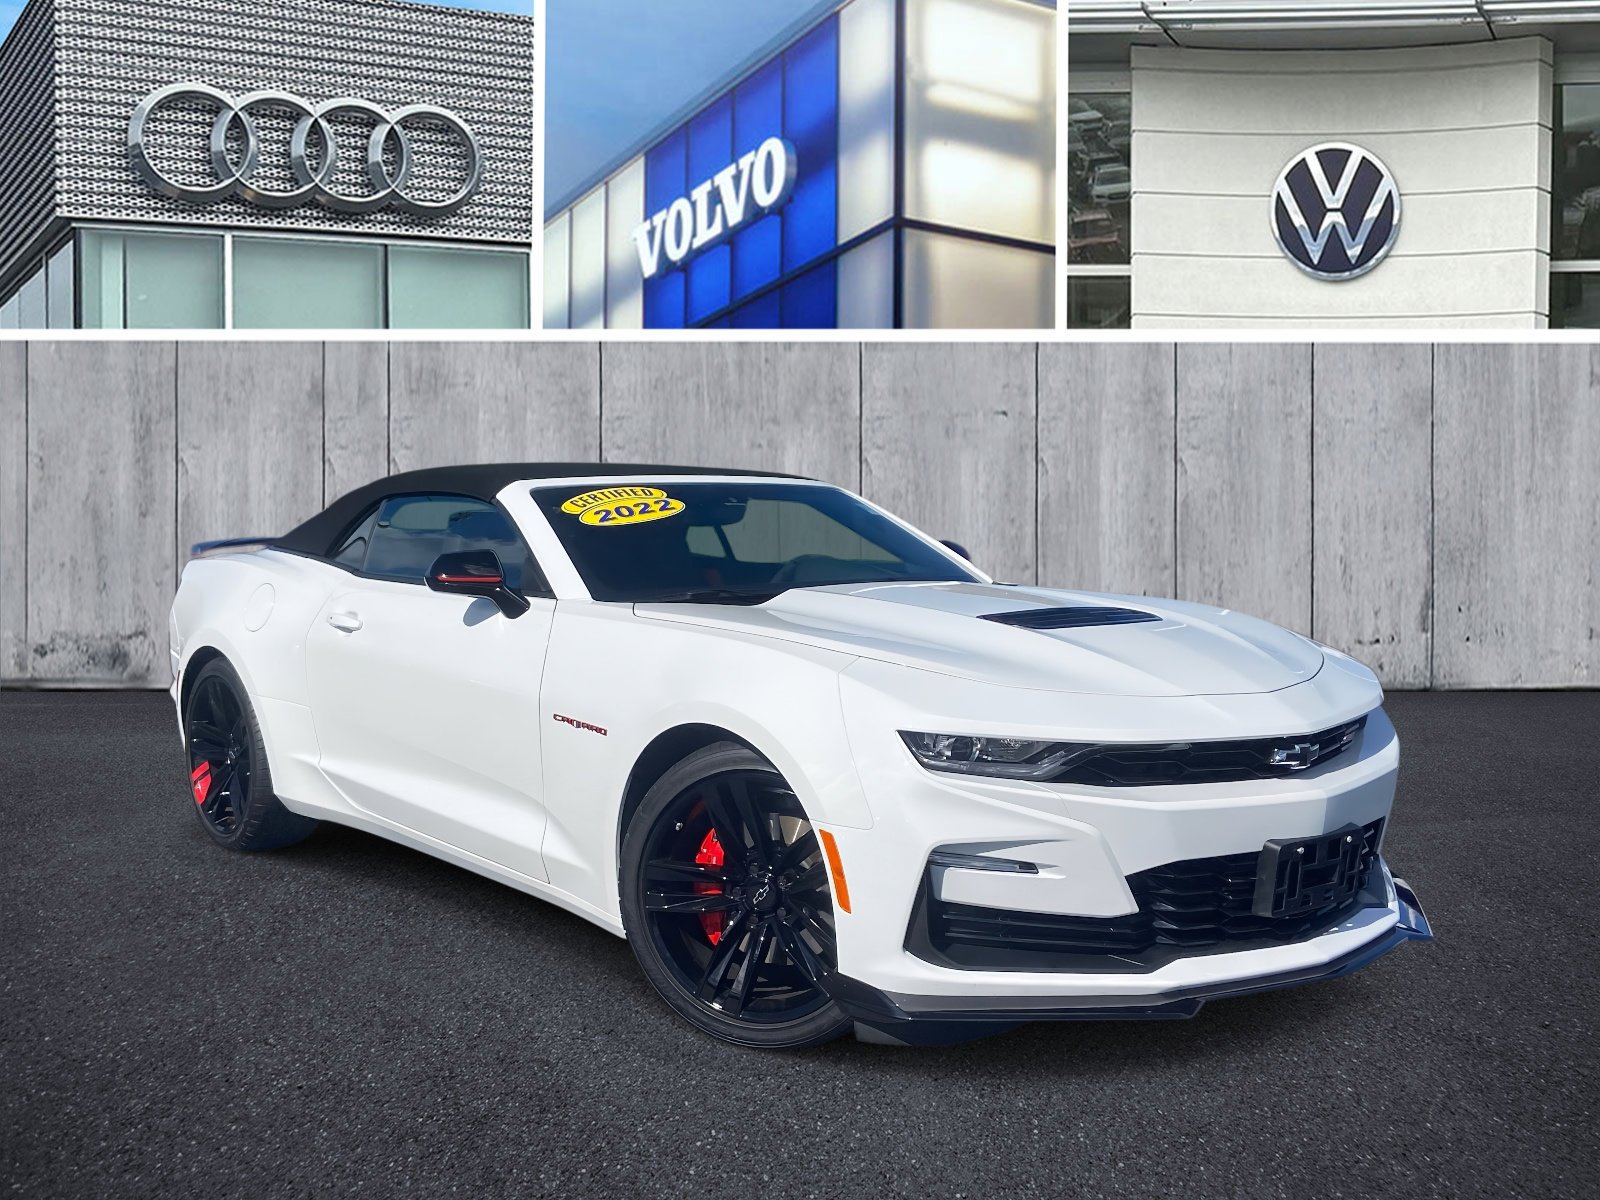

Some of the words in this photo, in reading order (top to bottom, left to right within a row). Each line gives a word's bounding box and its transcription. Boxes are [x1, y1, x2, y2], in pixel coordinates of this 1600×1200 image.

[634, 136, 786, 278] VOLVO
[570, 488, 654, 508] CERTIFIED
[594, 499, 676, 523] 2022
